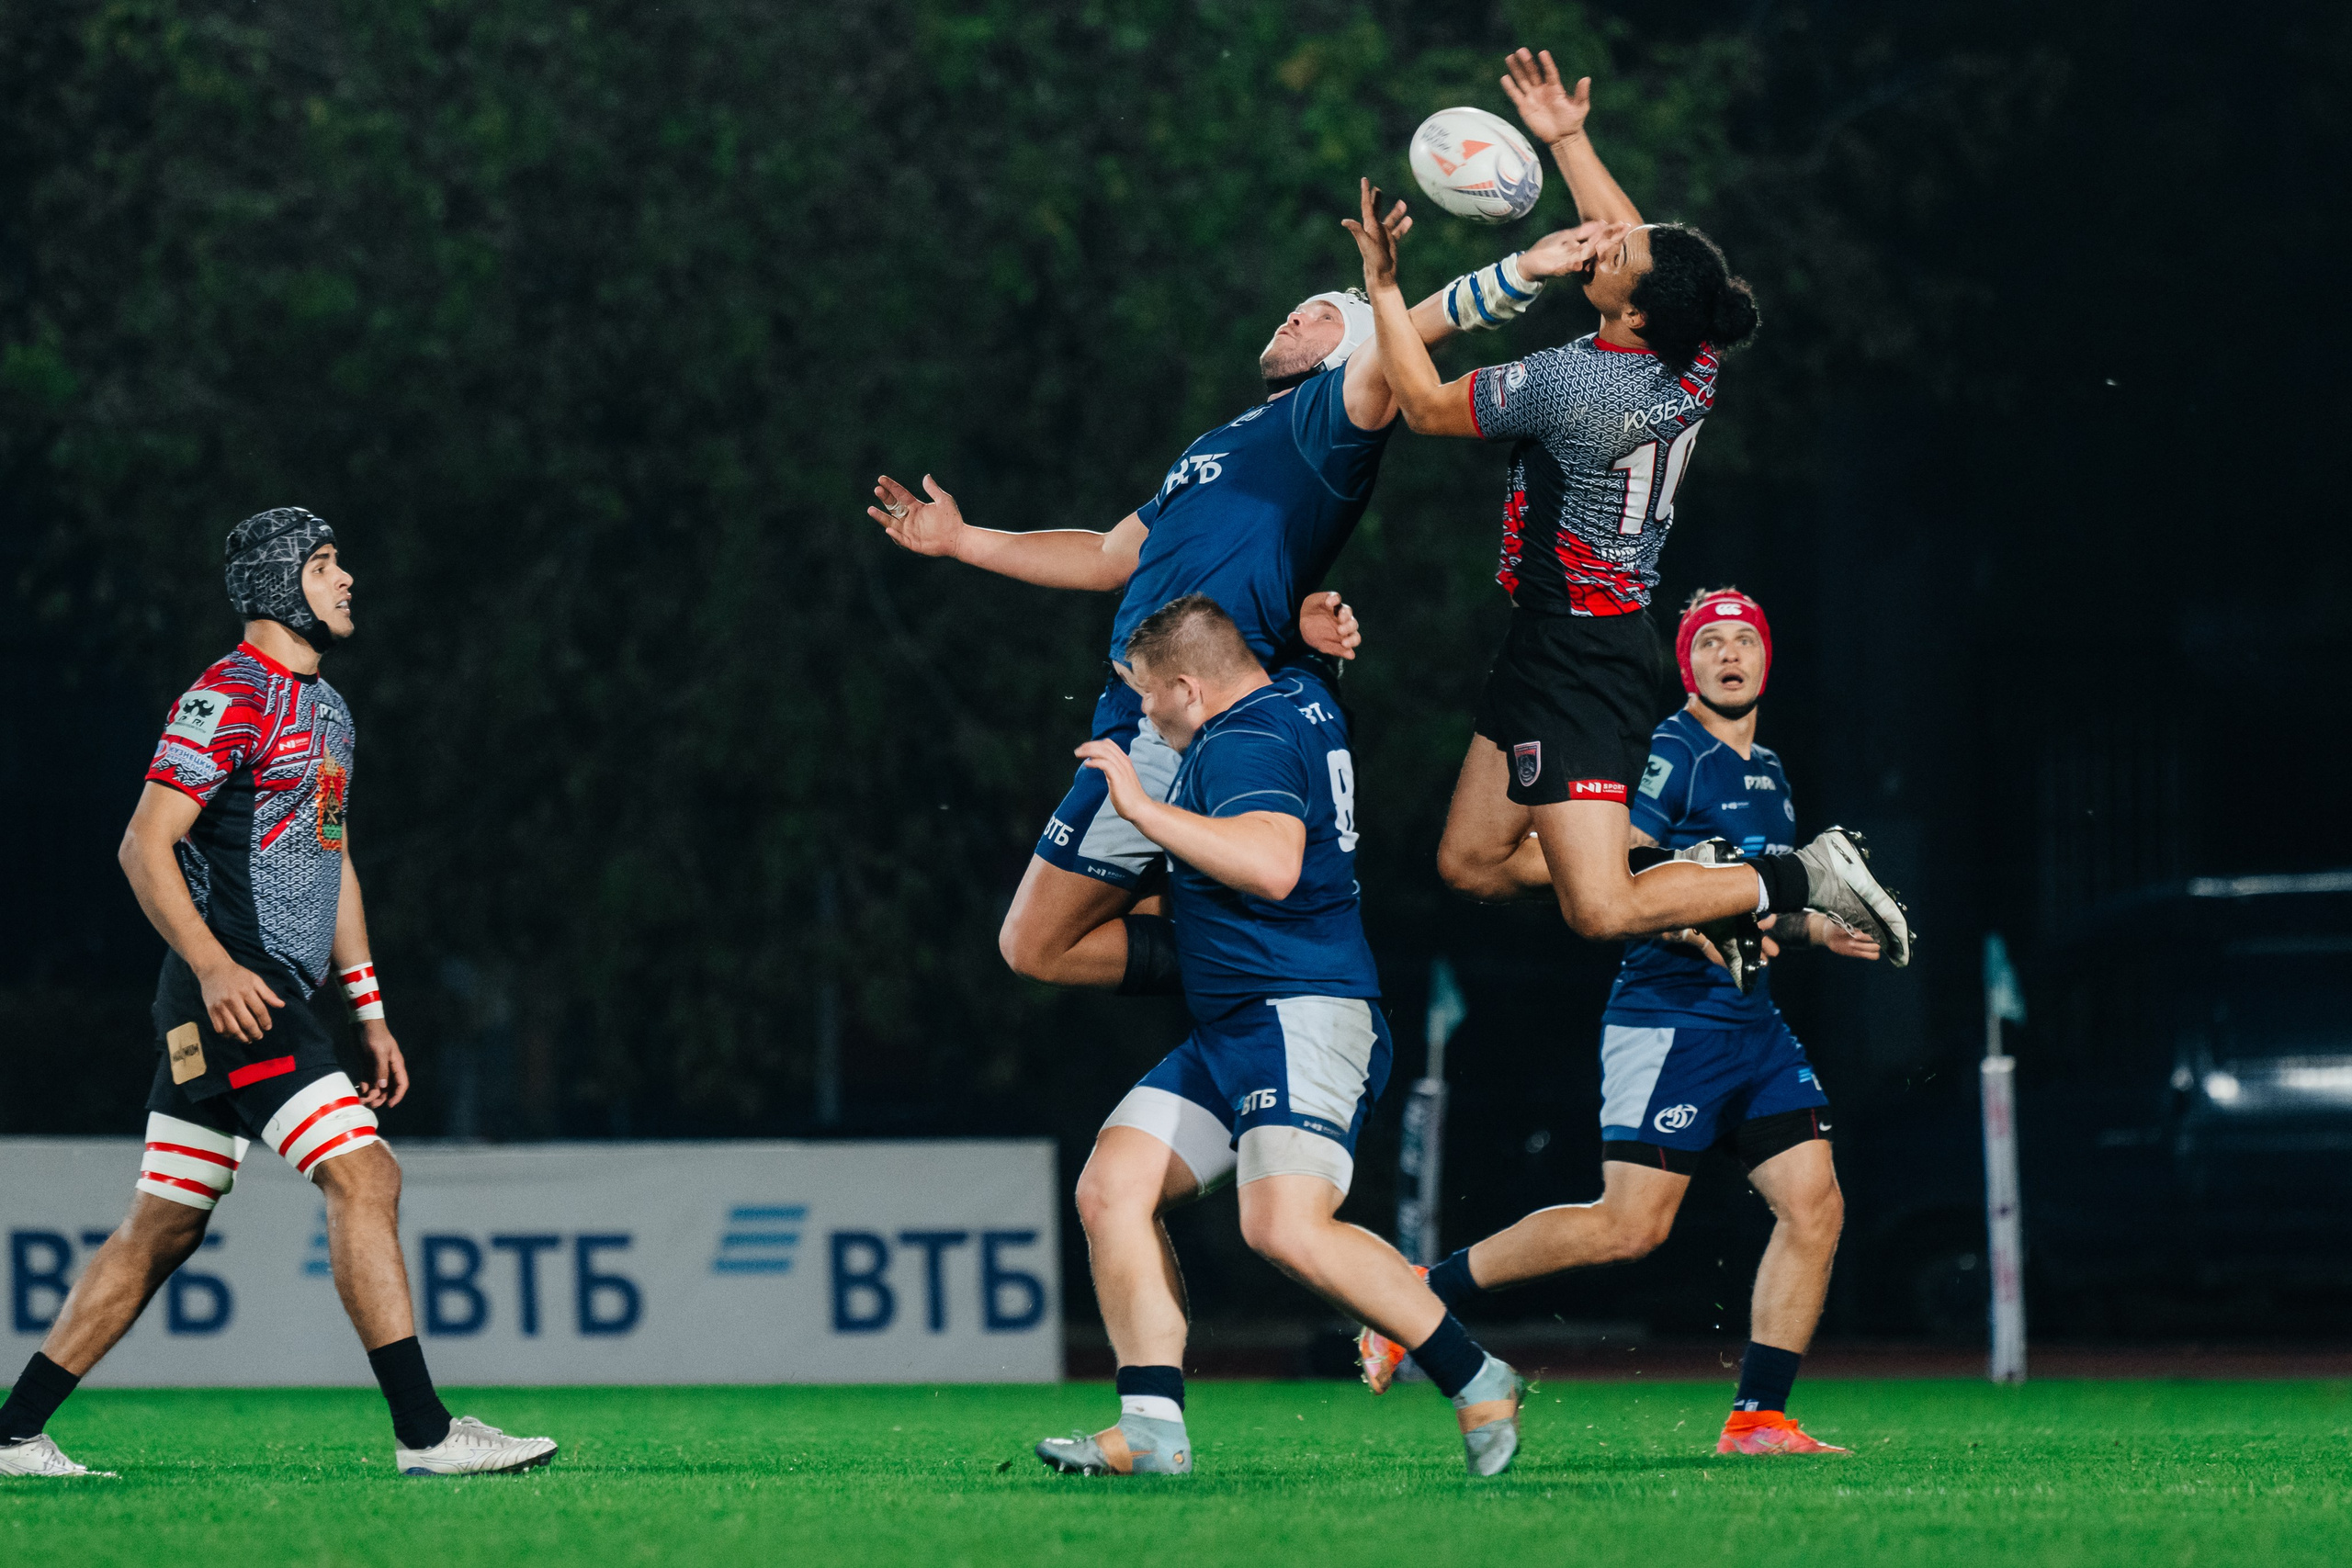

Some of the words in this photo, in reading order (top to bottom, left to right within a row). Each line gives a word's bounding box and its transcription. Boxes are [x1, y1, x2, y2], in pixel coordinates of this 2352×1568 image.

[1166, 452, 1230, 495] ВТБ
[1297, 702, 1335, 725] ВТ
[1326, 749, 1361, 852] 8
[1602, 783, 1625, 791] SPORT
[1044, 815, 1075, 847] ВТБ
[1240, 1088, 1278, 1116] ВТБ
[8, 1230, 234, 1335] ВБ
[419, 1233, 644, 1337] ВТБ
[829, 1230, 1046, 1334] ВТБ
